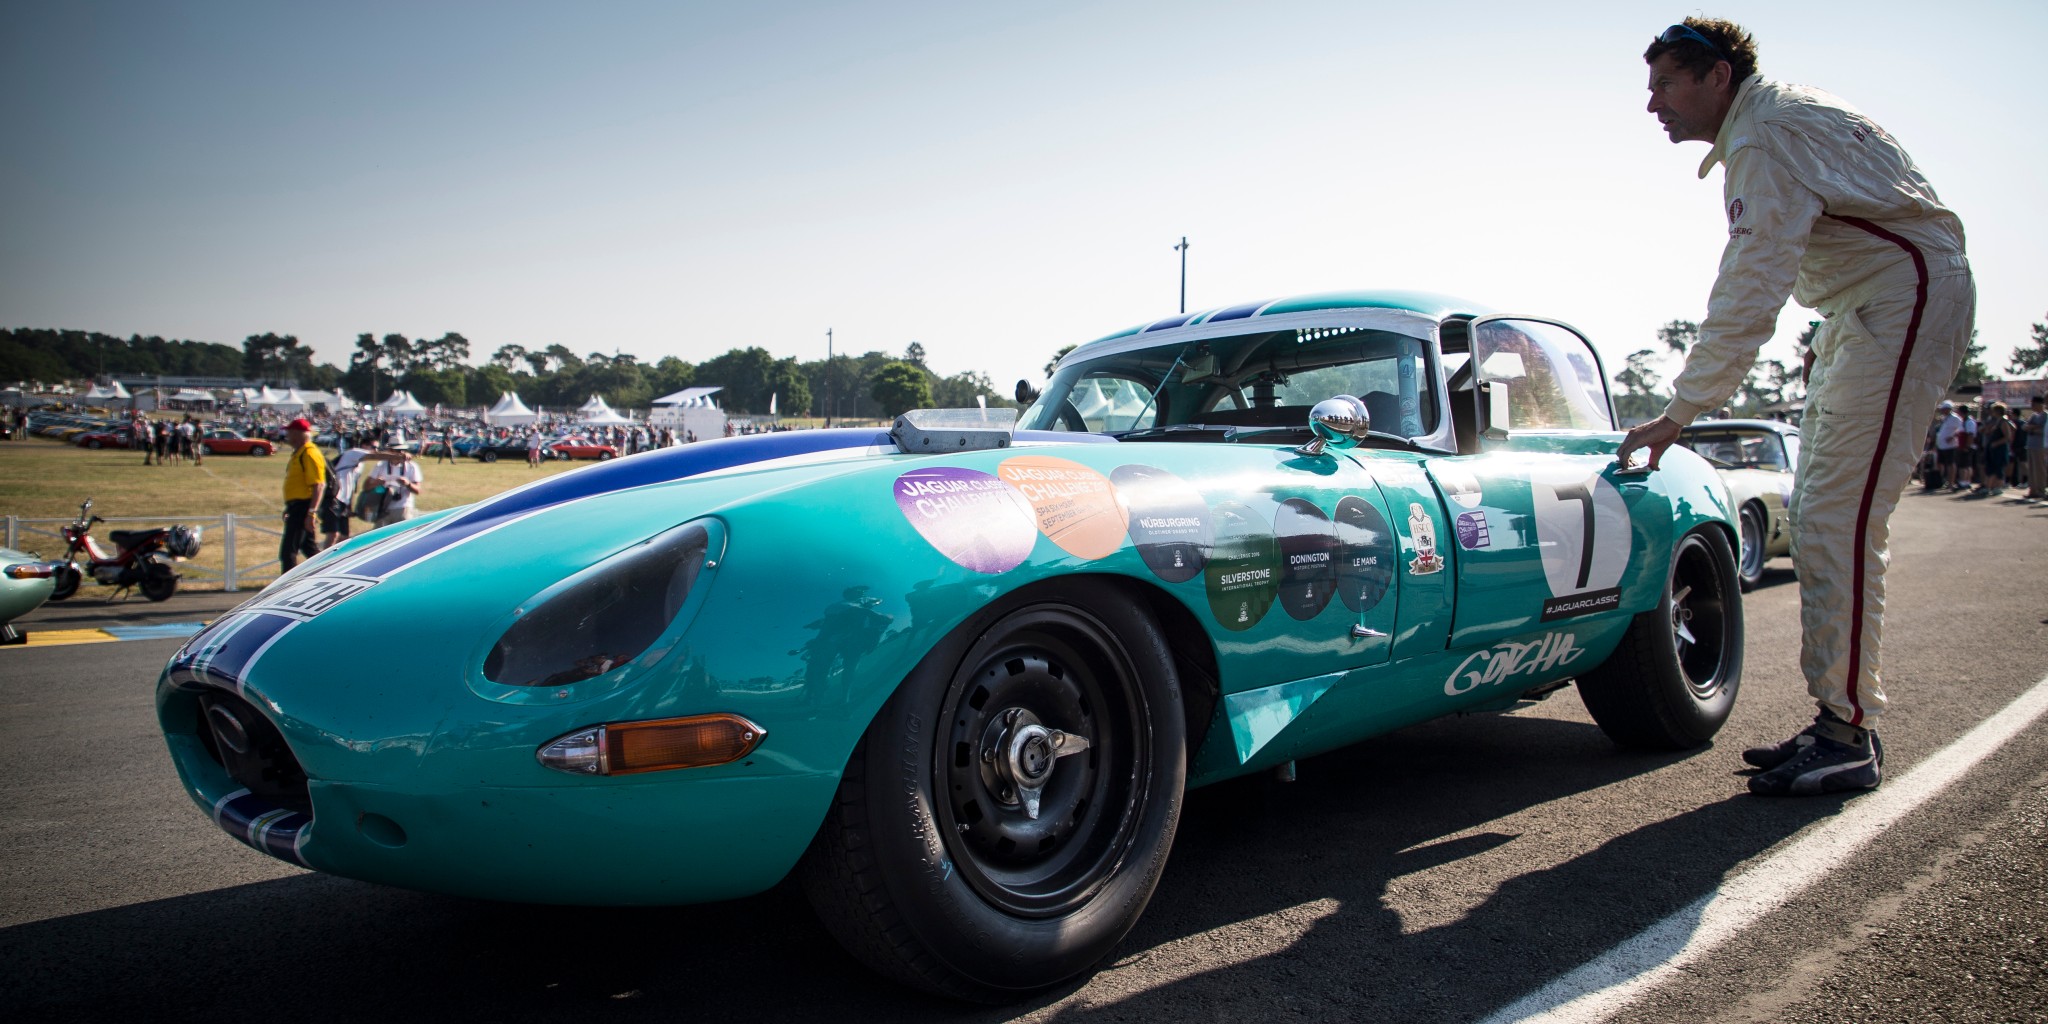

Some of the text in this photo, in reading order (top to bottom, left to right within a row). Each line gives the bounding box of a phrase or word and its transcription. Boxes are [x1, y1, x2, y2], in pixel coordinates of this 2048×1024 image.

[1005, 467, 1066, 481] JAGUAR
[901, 480, 970, 497] JAGUAR
[1020, 481, 1090, 502] CHALLENGE
[1042, 511, 1077, 529] SEPTEMBER
[1140, 516, 1201, 529] NÜRBURGRING
[1552, 482, 1596, 589] 7
[1290, 552, 1330, 565] DONINGTON
[1352, 556, 1377, 567] LE MANS
[1221, 568, 1270, 584] SILVERSTONE
[1221, 583, 1253, 592] INTERNATIONAL
[1545, 593, 1619, 615] #JAGUARCLASSIC
[902, 711, 925, 842] RACING
